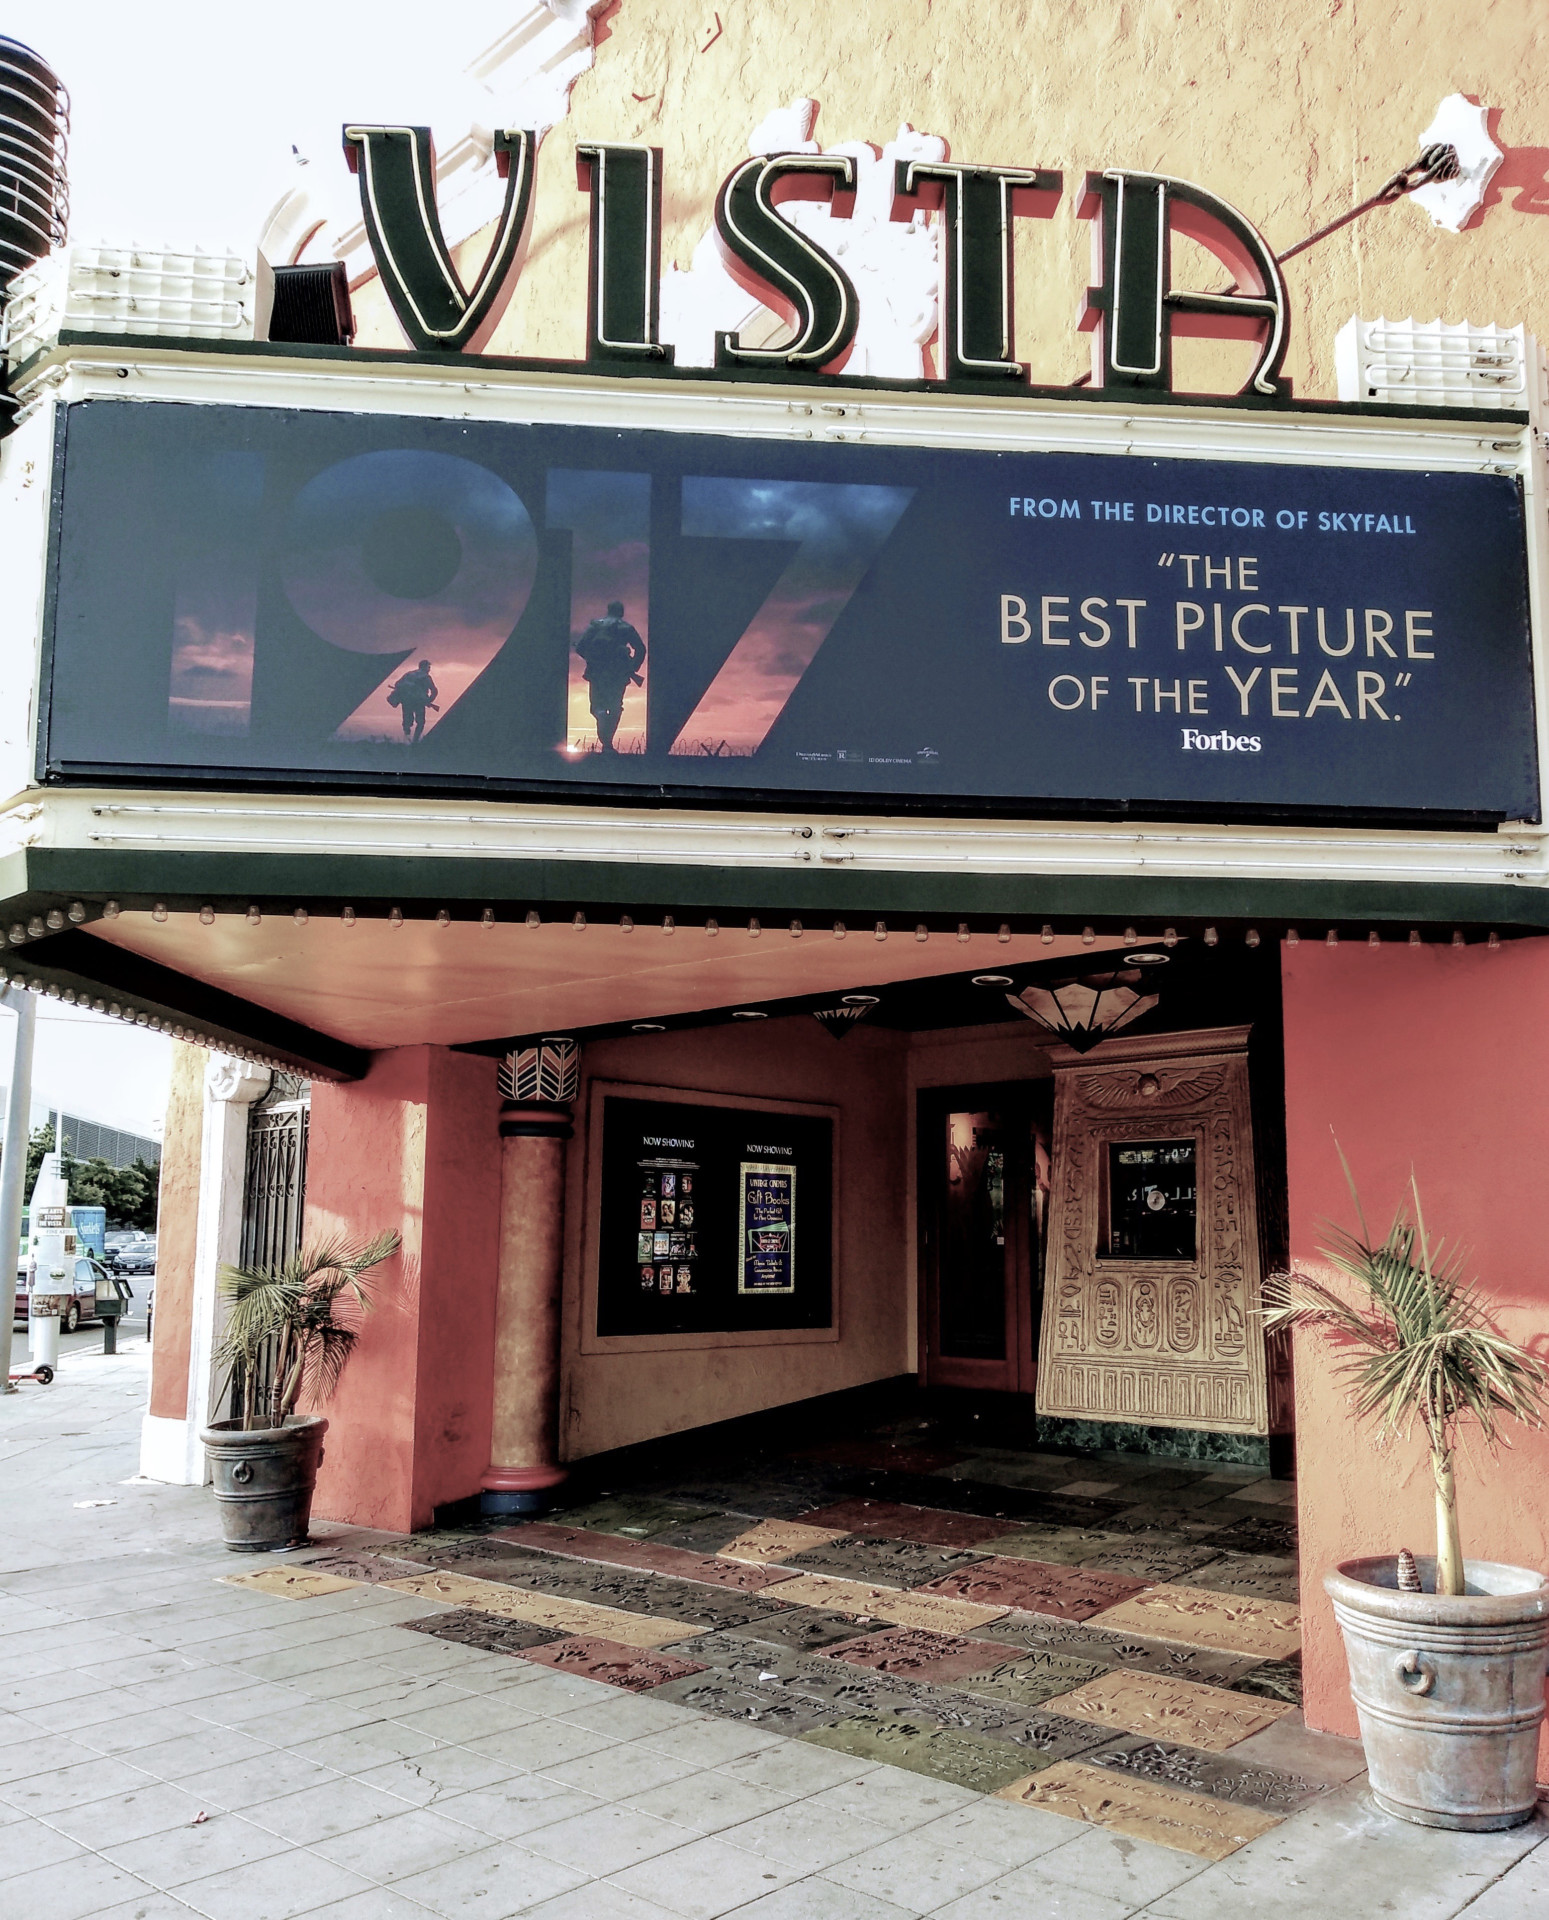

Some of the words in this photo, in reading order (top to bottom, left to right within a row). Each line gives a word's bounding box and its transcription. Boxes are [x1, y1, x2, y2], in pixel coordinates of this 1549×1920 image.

[342, 124, 1293, 397] VISTA
[1010, 497, 1081, 519] FROM
[1091, 501, 1135, 522] THE
[1147, 503, 1266, 528] DIRECTOR
[1276, 509, 1308, 530] OF
[1318, 511, 1417, 534] SKYFALL
[168, 449, 919, 758] 1917
[1001, 594, 1147, 649] BEST
[1176, 602, 1435, 659] PICTURE
[1048, 674, 1109, 711] OF
[1128, 677, 1208, 714] THE
[1181, 728, 1262, 753] Forbes
[643, 1136, 661, 1146] NOW
[661, 1138, 695, 1149] SHOWING
[746, 1144, 763, 1153] NOW
[763, 1145, 793, 1156] SHOWING
[747, 1190, 762, 1205] Gift
[764, 1191, 790, 1205] Books
